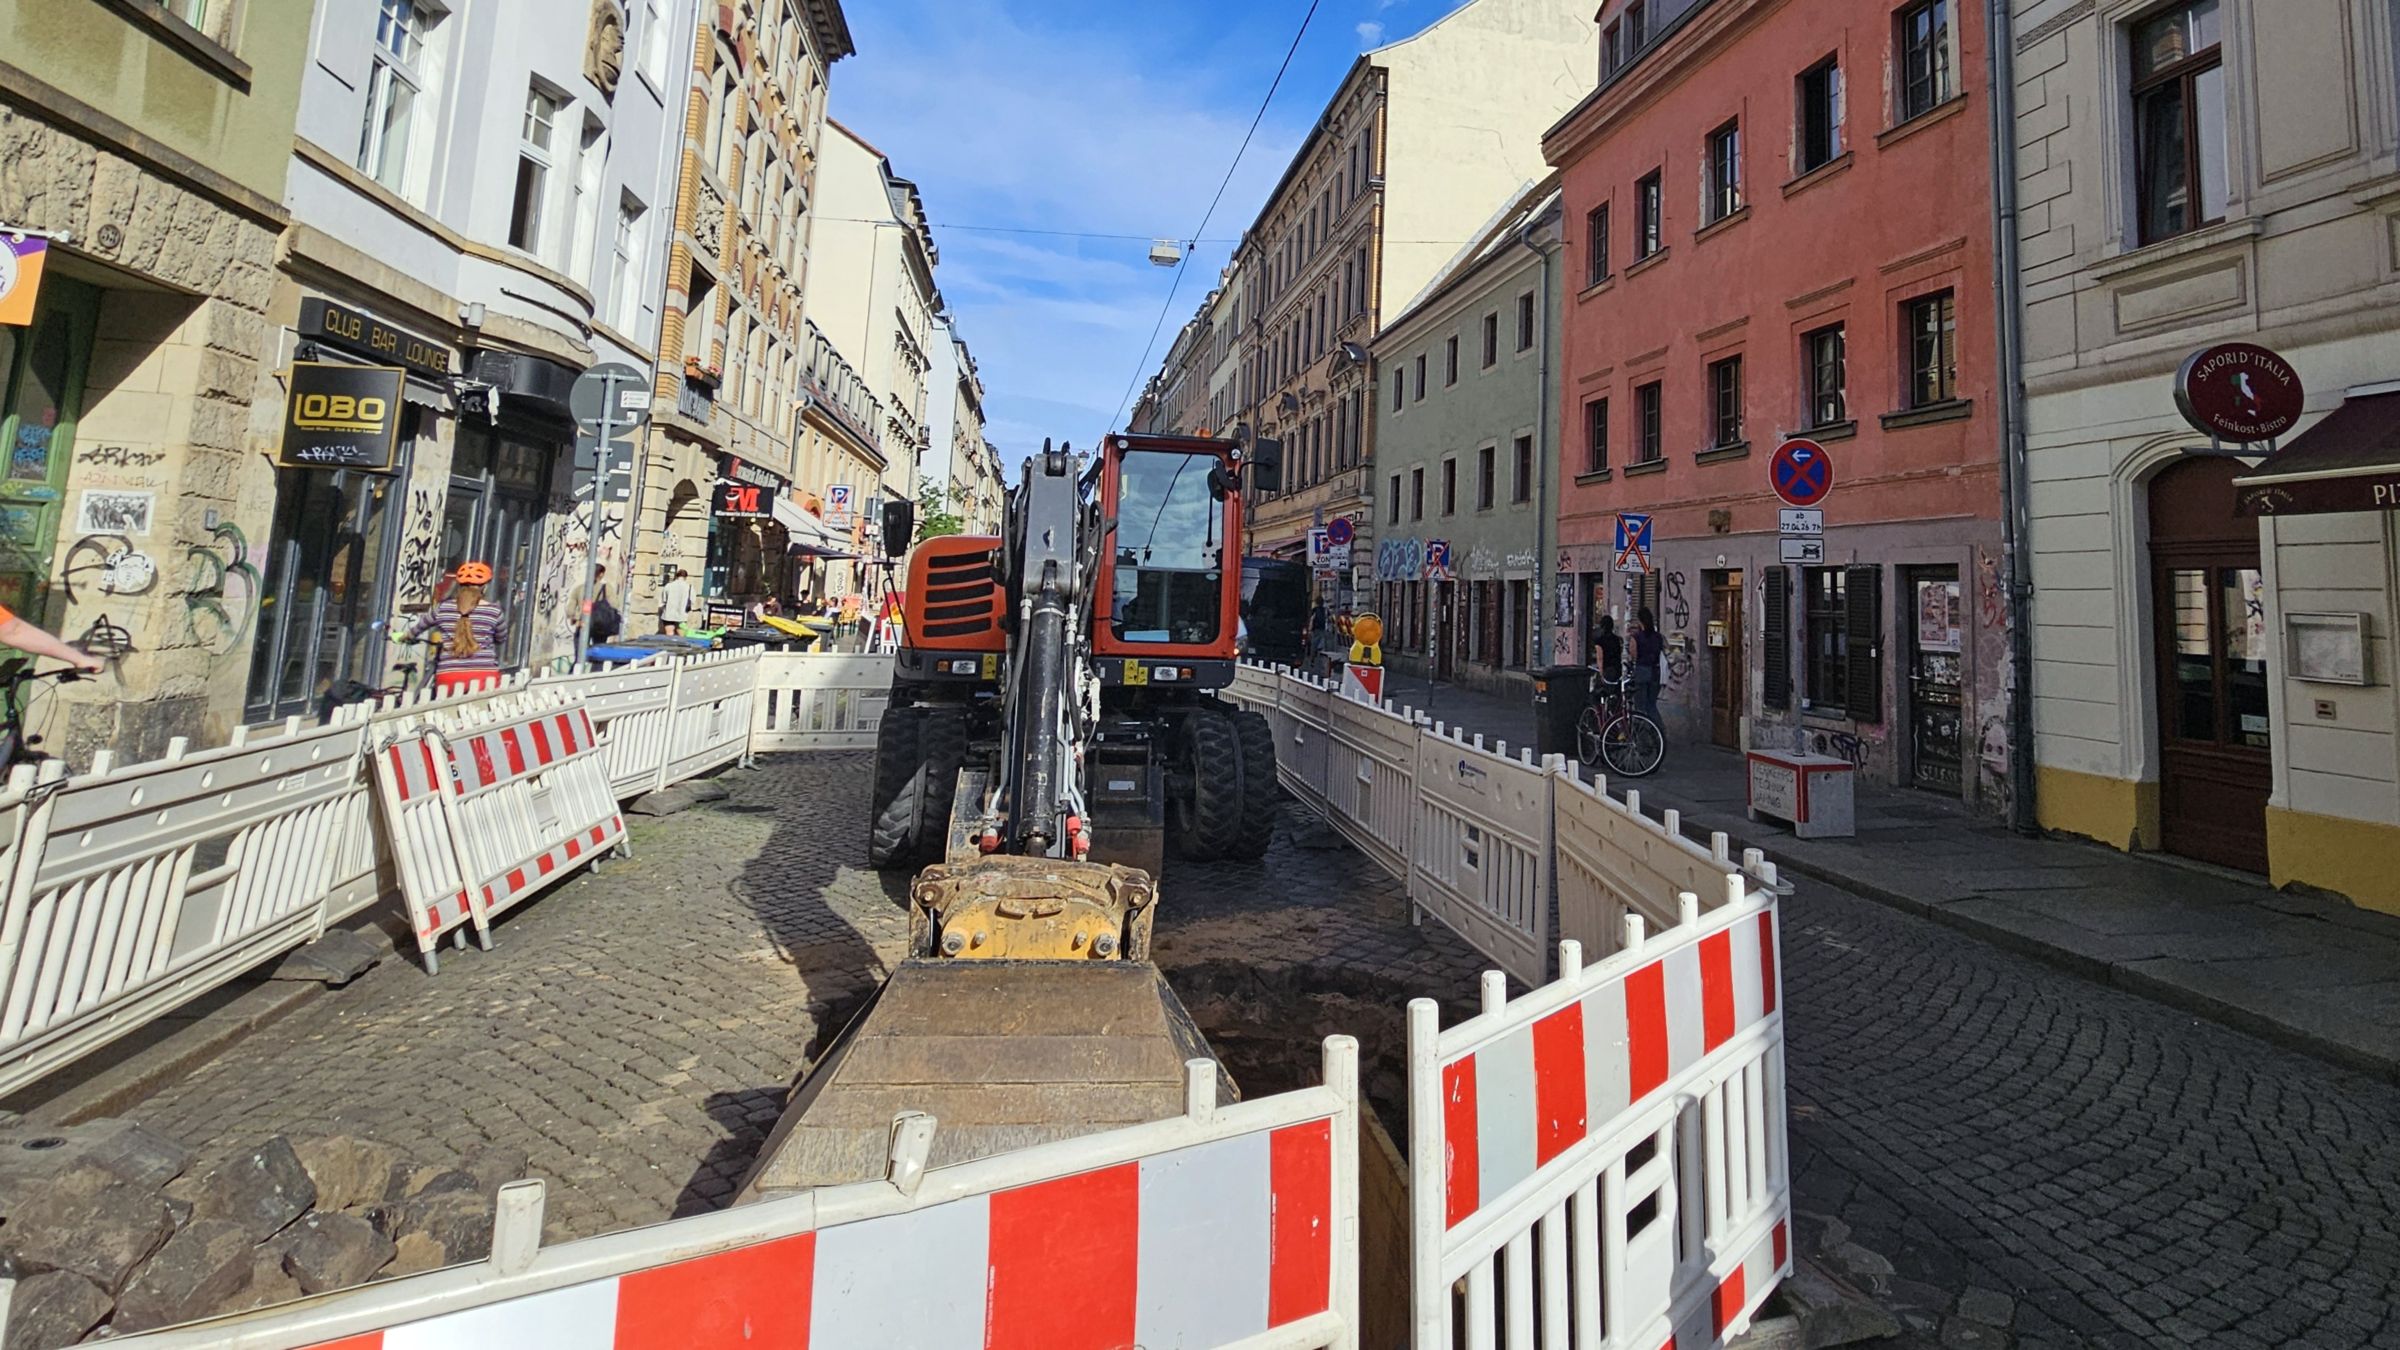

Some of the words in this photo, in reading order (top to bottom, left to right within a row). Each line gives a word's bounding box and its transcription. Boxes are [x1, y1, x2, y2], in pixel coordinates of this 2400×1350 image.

[325, 309, 361, 340] CLUB
[371, 327, 397, 352] BAR
[406, 342, 448, 372] LOUNGE
[2197, 352, 2237, 381] SAPORI
[293, 393, 386, 430] LOBO
[2213, 413, 2256, 434] Feinkost
[2260, 415, 2287, 433] Bistro
[2373, 483, 2400, 505] PI
[1795, 512, 1805, 520] ab
[1623, 519, 1643, 548] P
